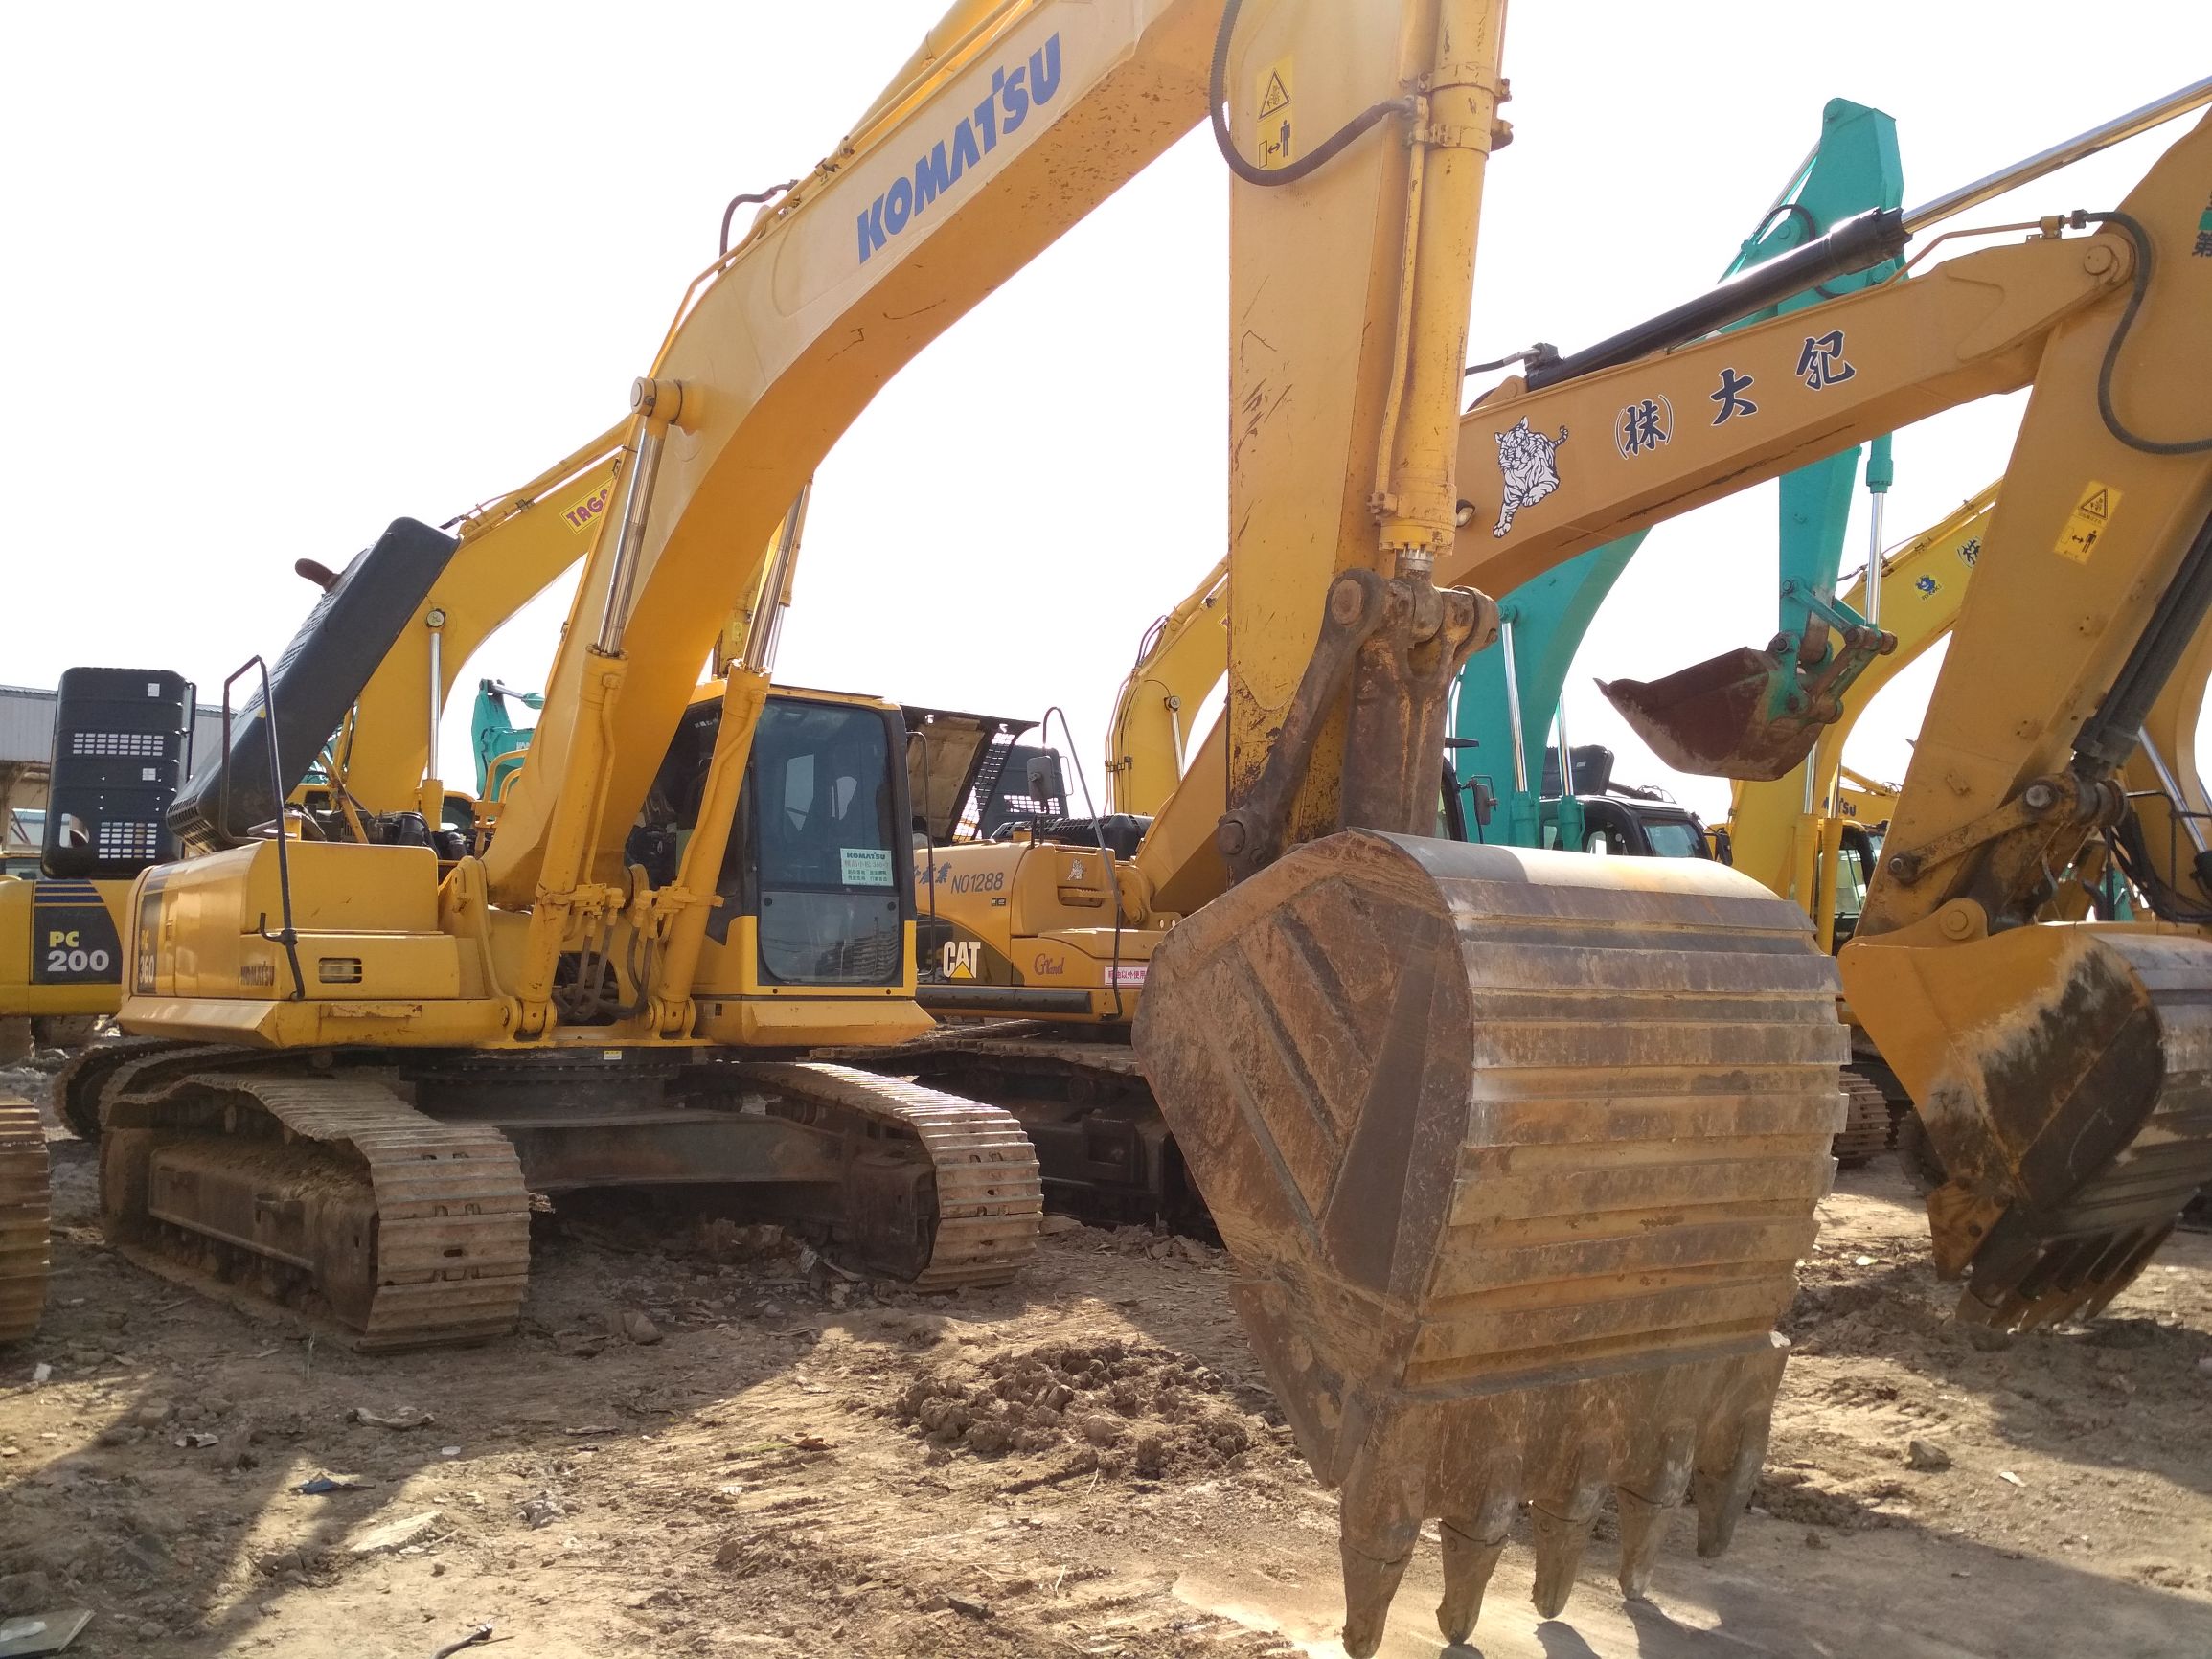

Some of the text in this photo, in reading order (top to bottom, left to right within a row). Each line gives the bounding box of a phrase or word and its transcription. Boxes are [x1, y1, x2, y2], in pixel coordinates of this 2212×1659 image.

[857, 31, 1061, 265] KOMATSU
[49, 931, 80, 947] PC
[47, 949, 110, 972] 200
[139, 955, 154, 983] 360
[943, 941, 981, 978] CAT
